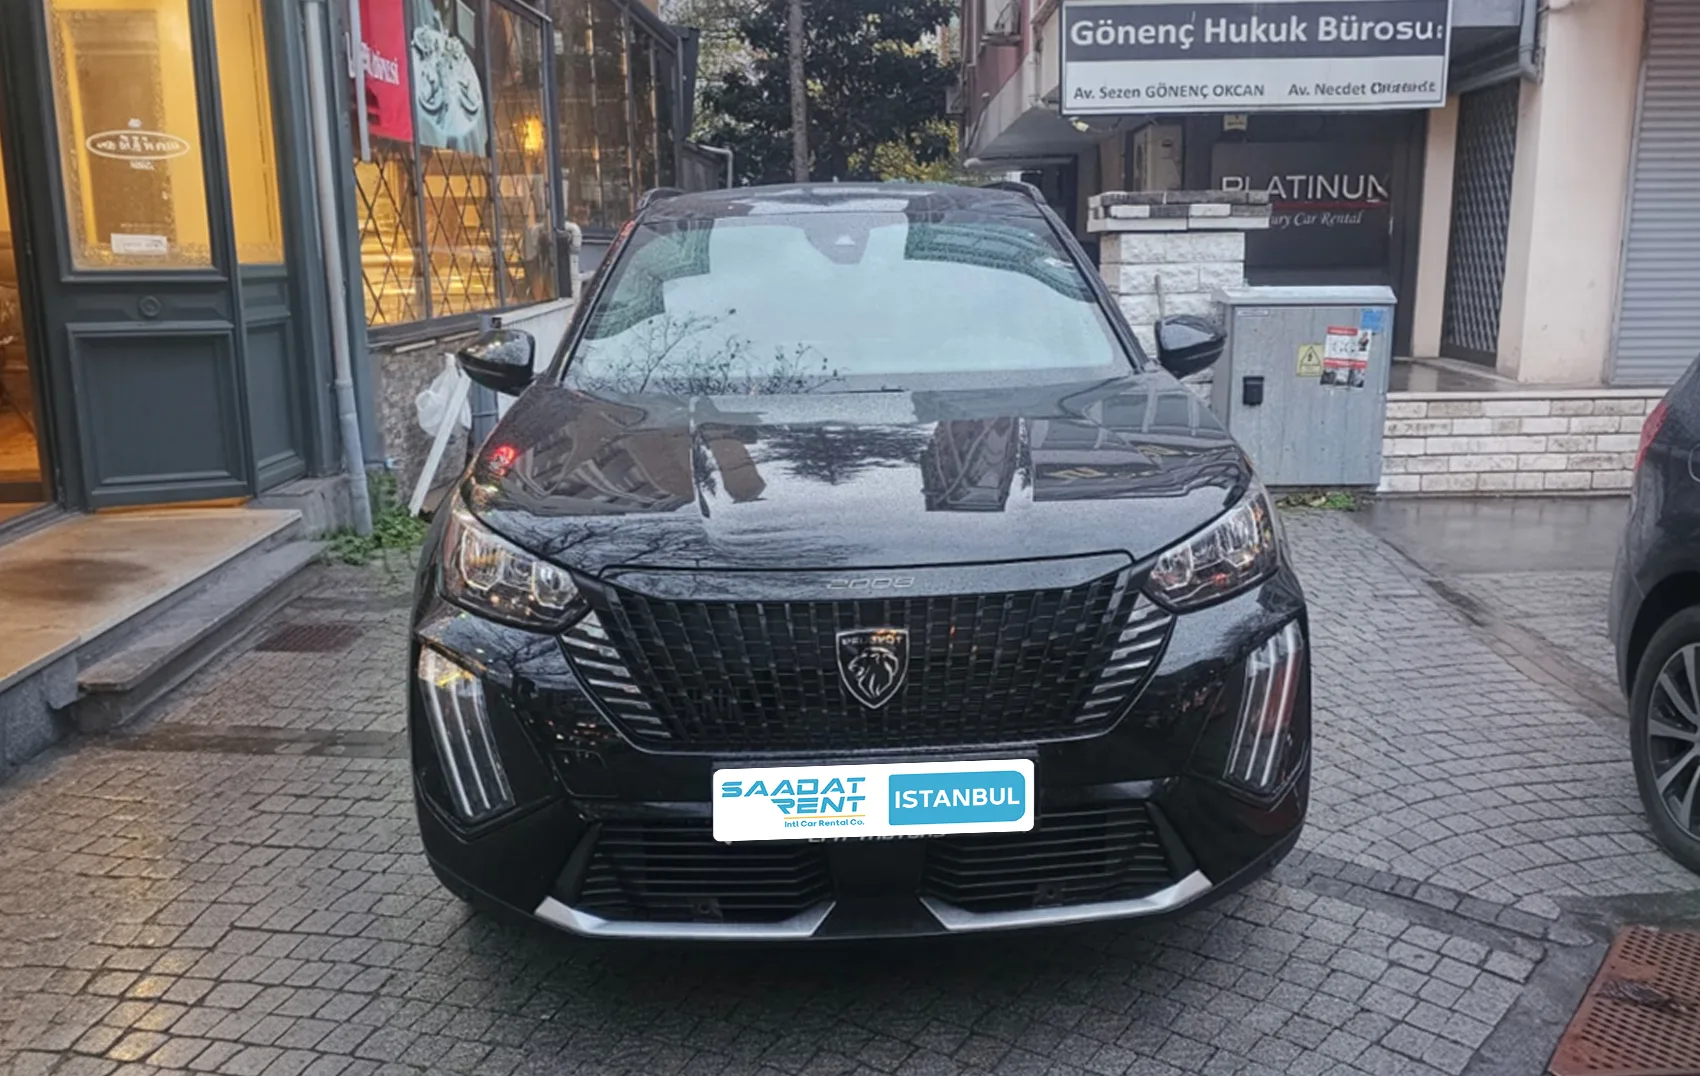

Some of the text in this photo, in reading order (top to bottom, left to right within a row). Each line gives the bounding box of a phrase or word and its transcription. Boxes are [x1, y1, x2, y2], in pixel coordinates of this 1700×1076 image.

[1070, 19, 1194, 50] Gönenç
[1204, 16, 1308, 44] Hukuk
[1073, 82, 1265, 100] Av. Sezen GÖNENÇ OKCAN
[1288, 83, 1310, 96] Av.
[1314, 82, 1366, 96] Necdet
[1294, 212, 1317, 226] Car
[1321, 211, 1363, 226] Rental
[826, 576, 916, 590] 2008
